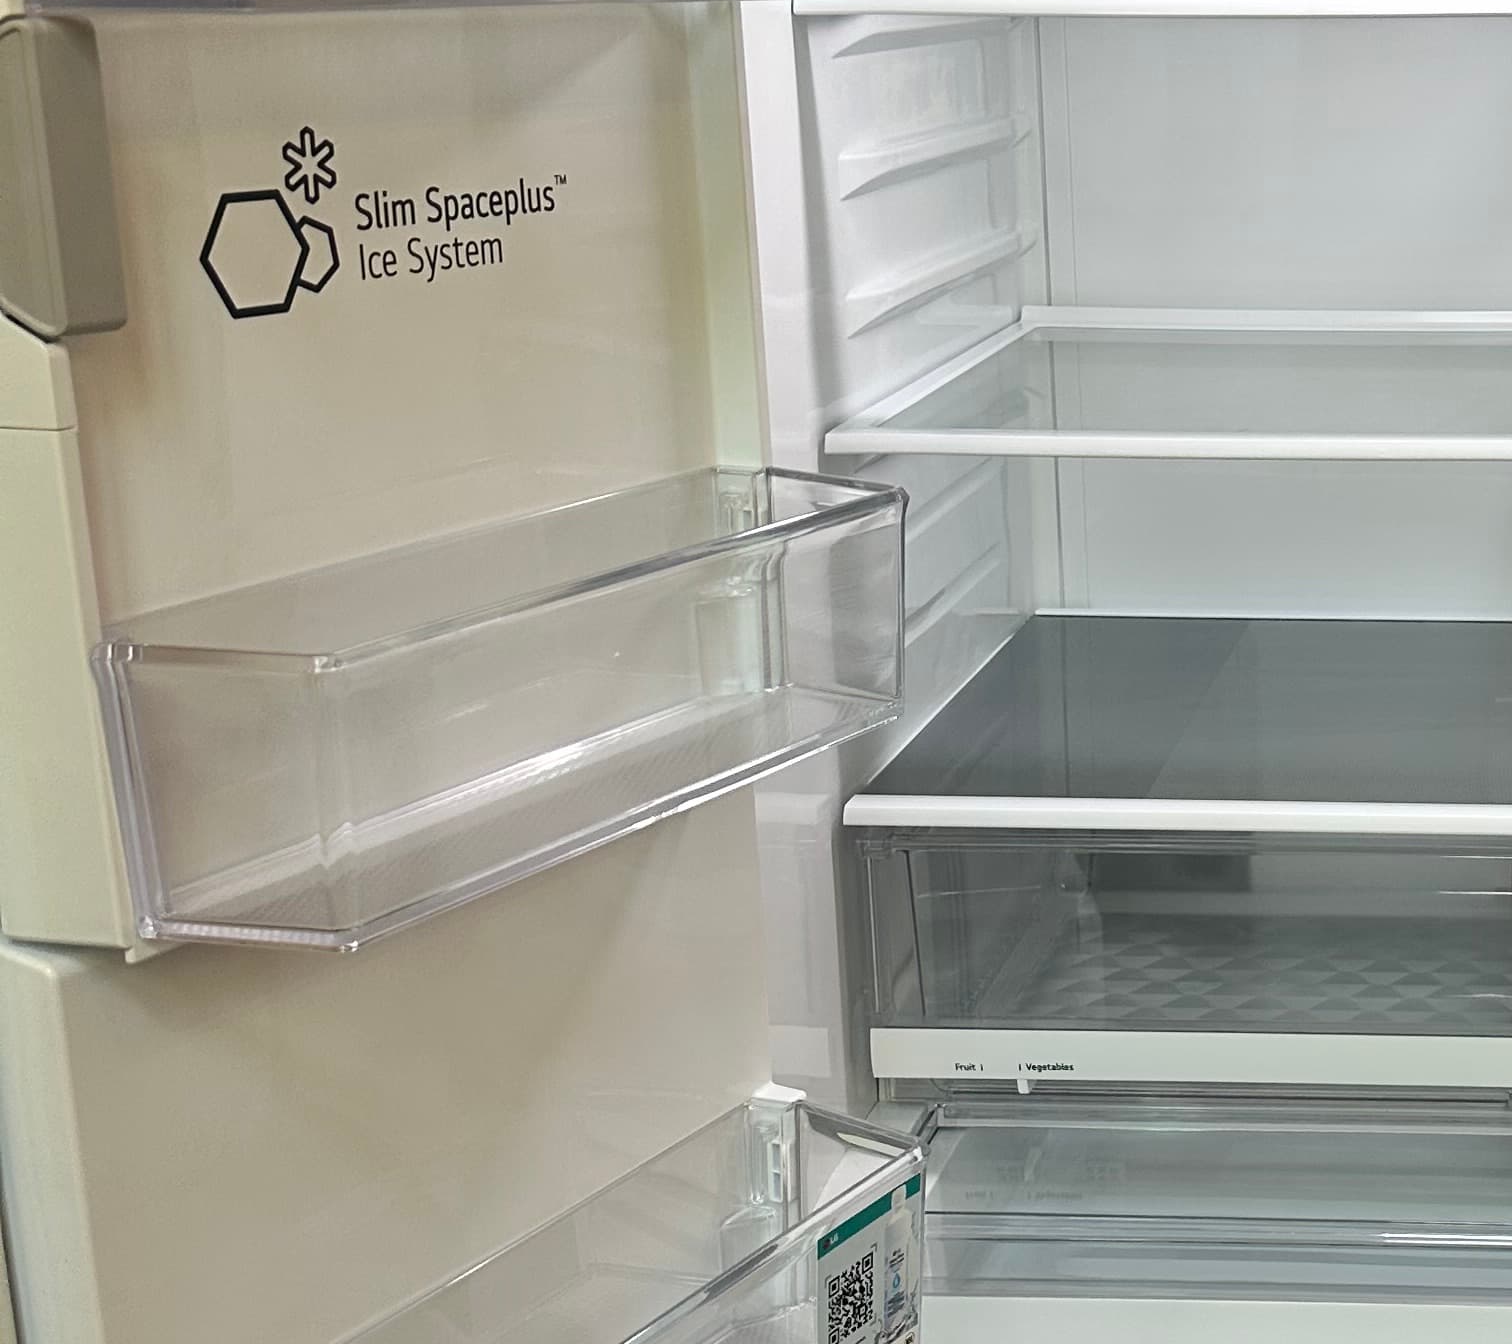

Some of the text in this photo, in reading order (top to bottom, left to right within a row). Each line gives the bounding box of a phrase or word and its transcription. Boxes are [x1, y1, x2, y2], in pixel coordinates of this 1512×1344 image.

[355, 190, 417, 231] Slim
[359, 236, 504, 282] Ice System
[954, 1062, 1075, 1073] Fruit Vegetables
